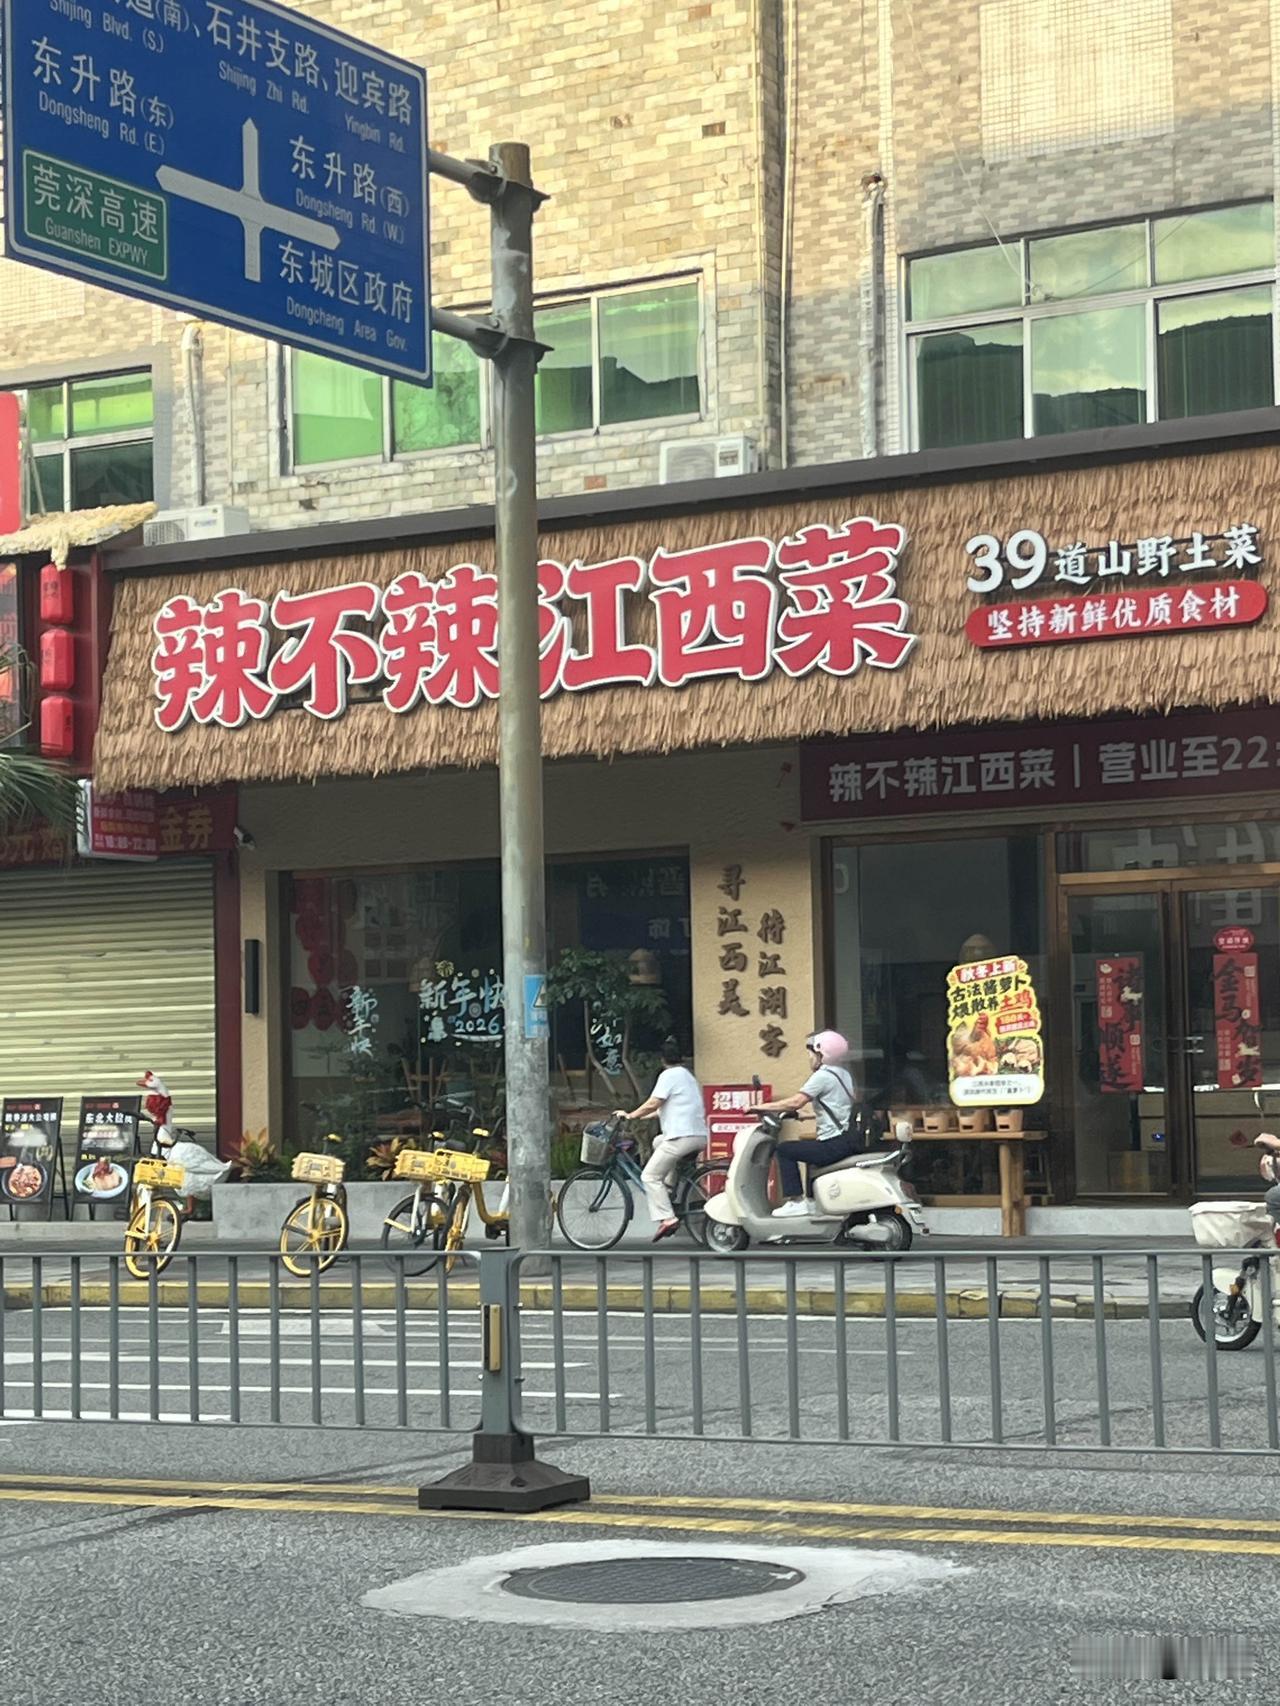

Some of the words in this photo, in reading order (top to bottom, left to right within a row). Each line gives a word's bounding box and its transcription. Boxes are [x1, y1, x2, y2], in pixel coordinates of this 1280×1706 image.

[218, 60, 257, 97] Shijing
[266, 80, 283, 104] Zhi
[38, 90, 110, 139] Dongsheng
[345, 112, 381, 144] Yingbin
[32, 163, 159, 244] 莞深高速
[296, 188, 353, 229] Dongsheng
[45, 216, 101, 250] Guanshen
[279, 240, 413, 323] 东城区政府
[354, 319, 377, 342] Area
[152, 516, 916, 732] 辣不辣江西菜
[988, 586, 1241, 641] 坚持新鲜优质食材
[829, 748, 1056, 802] 辣不辣江西菜
[717, 864, 750, 1018] 寻江西美
[757, 909, 788, 1058] 待江湖客
[455, 1014, 500, 1035] 2026
